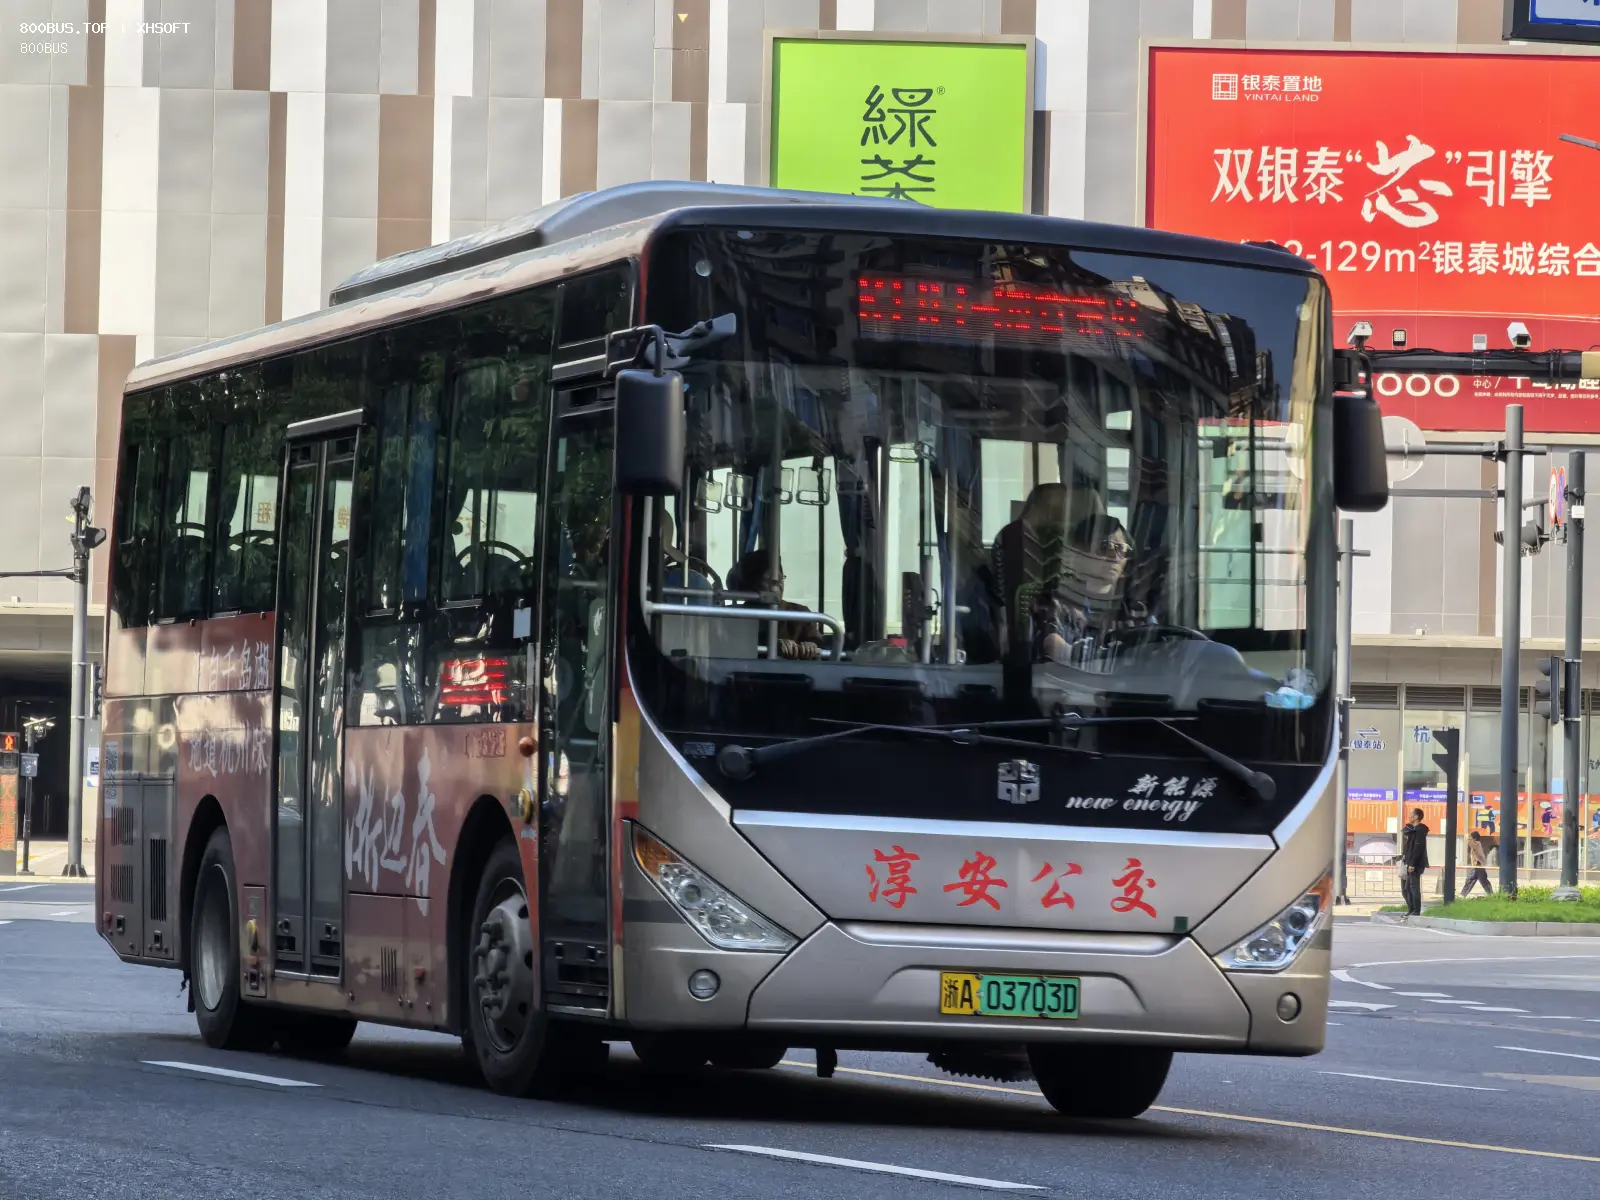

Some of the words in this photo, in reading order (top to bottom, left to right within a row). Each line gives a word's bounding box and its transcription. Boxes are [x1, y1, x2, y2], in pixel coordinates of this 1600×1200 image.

[1240, 74, 1323, 92] 银泰置地
[1243, 93, 1282, 102] YINTAI
[1285, 93, 1320, 102] LAND
[1127, 773, 1219, 799] 新能源
[1065, 795, 1118, 810] new
[1122, 797, 1203, 822] energy
[864, 844, 1158, 919] 淳安公交
